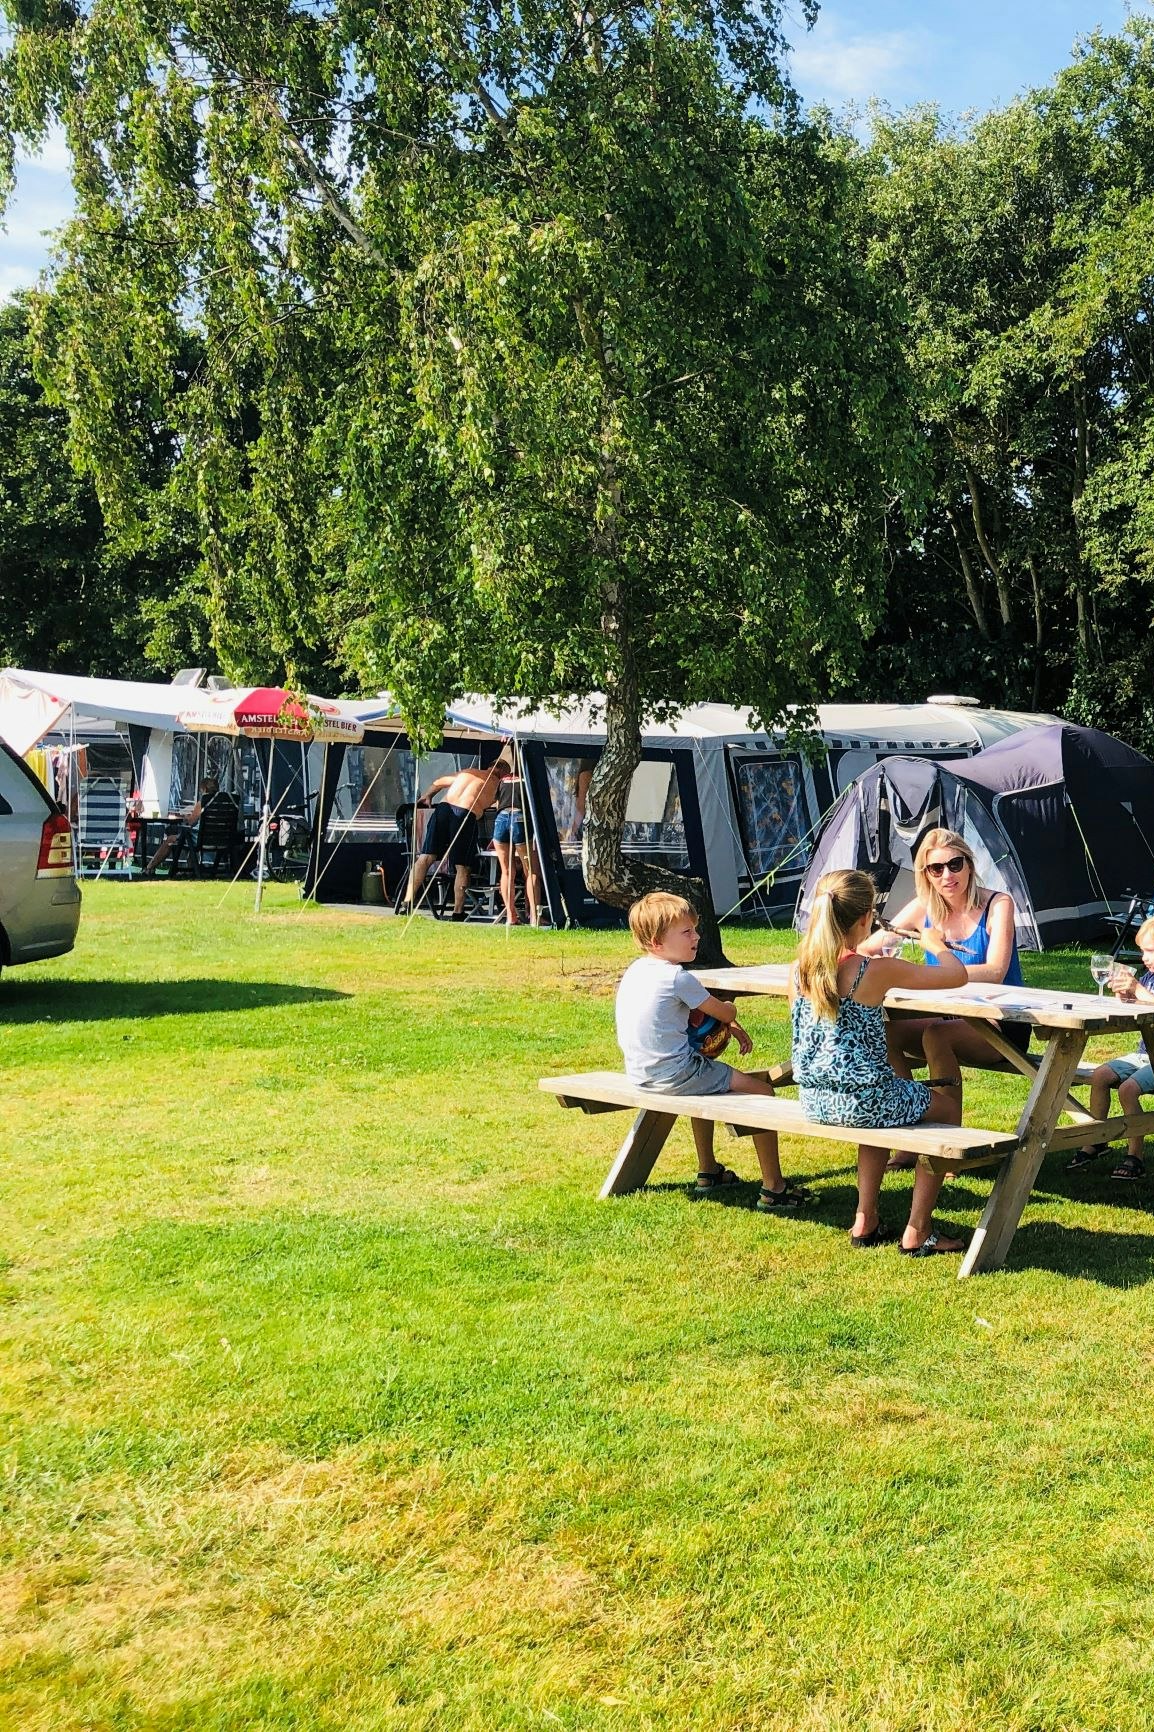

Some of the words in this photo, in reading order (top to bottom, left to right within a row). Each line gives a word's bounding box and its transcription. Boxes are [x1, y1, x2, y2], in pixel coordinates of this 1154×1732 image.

[241, 714, 276, 723] AMSTEL
[324, 719, 340, 729] STEL
[341, 721, 357, 732] BIER
